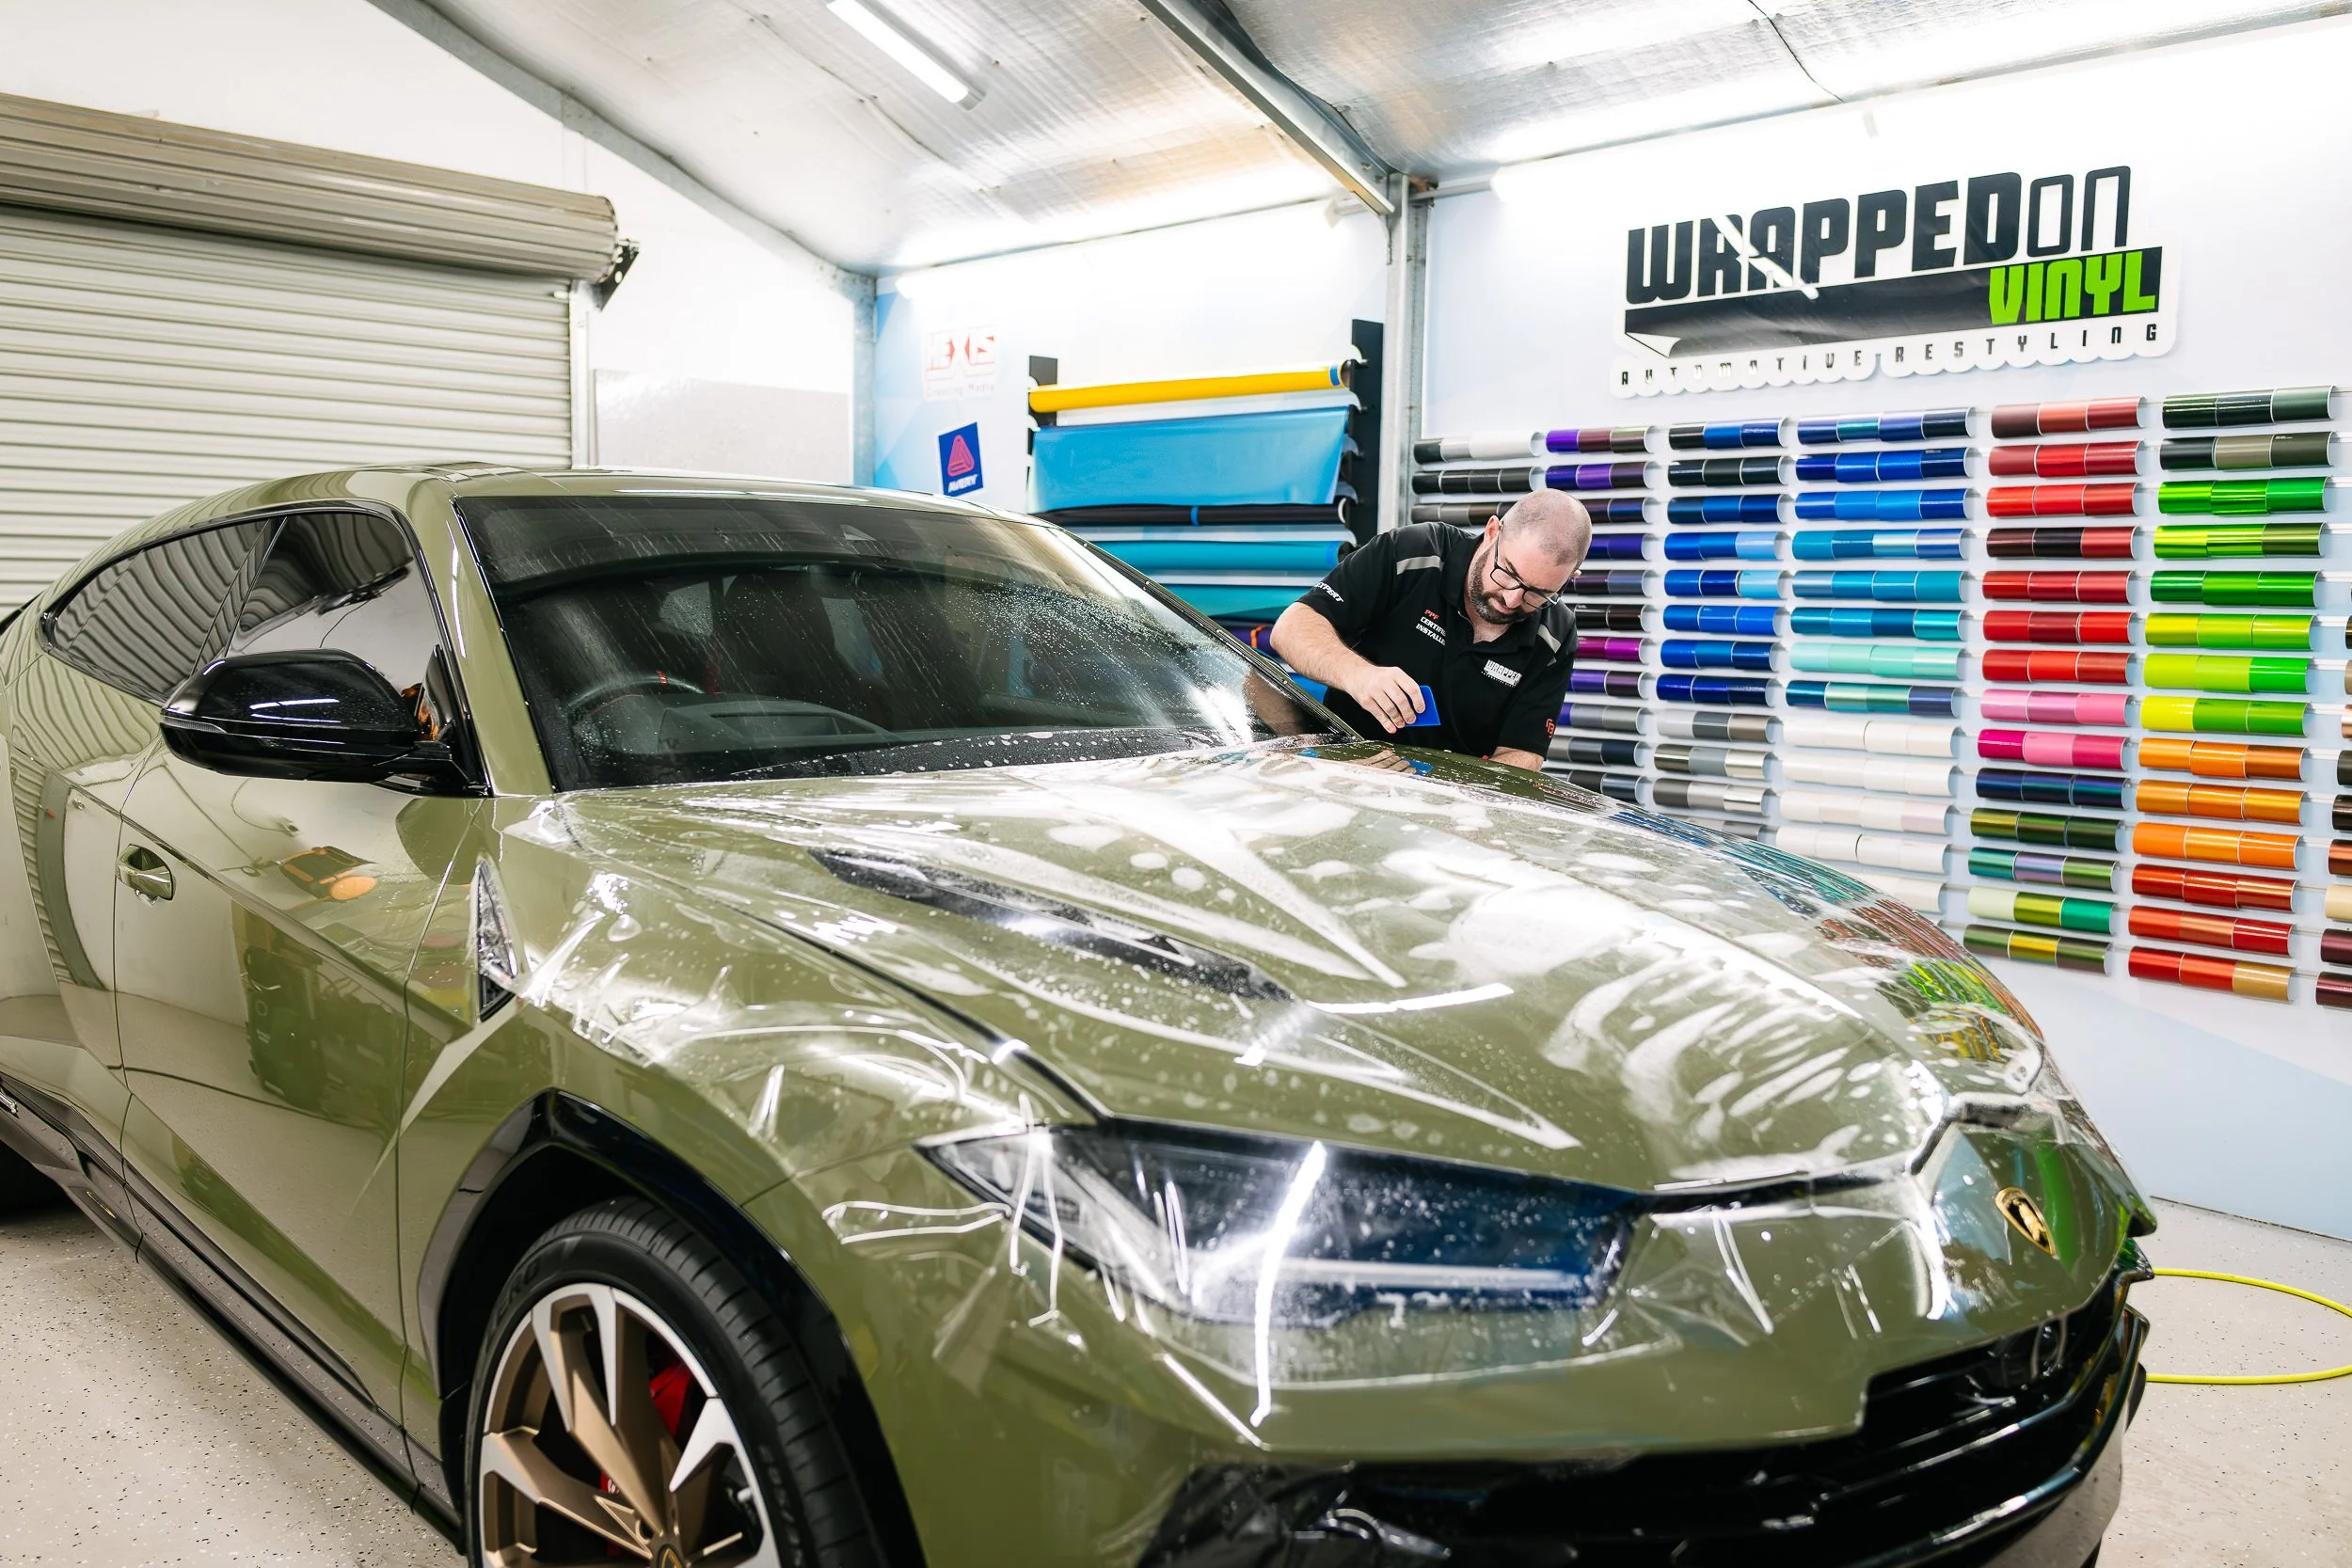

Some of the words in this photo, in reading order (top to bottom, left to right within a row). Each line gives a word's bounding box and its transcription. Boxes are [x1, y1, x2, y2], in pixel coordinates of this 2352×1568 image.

[1626, 172, 2022, 304] WRAPPED
[1989, 250, 2157, 325] VINYL
[1621, 350, 1862, 386] AUTOMOTIVE
[1895, 324, 2158, 363] RESTYLING
[948, 474, 978, 493] AVERY
[1415, 623, 1446, 646] INSTALLE
[1424, 609, 1439, 620] PPF
